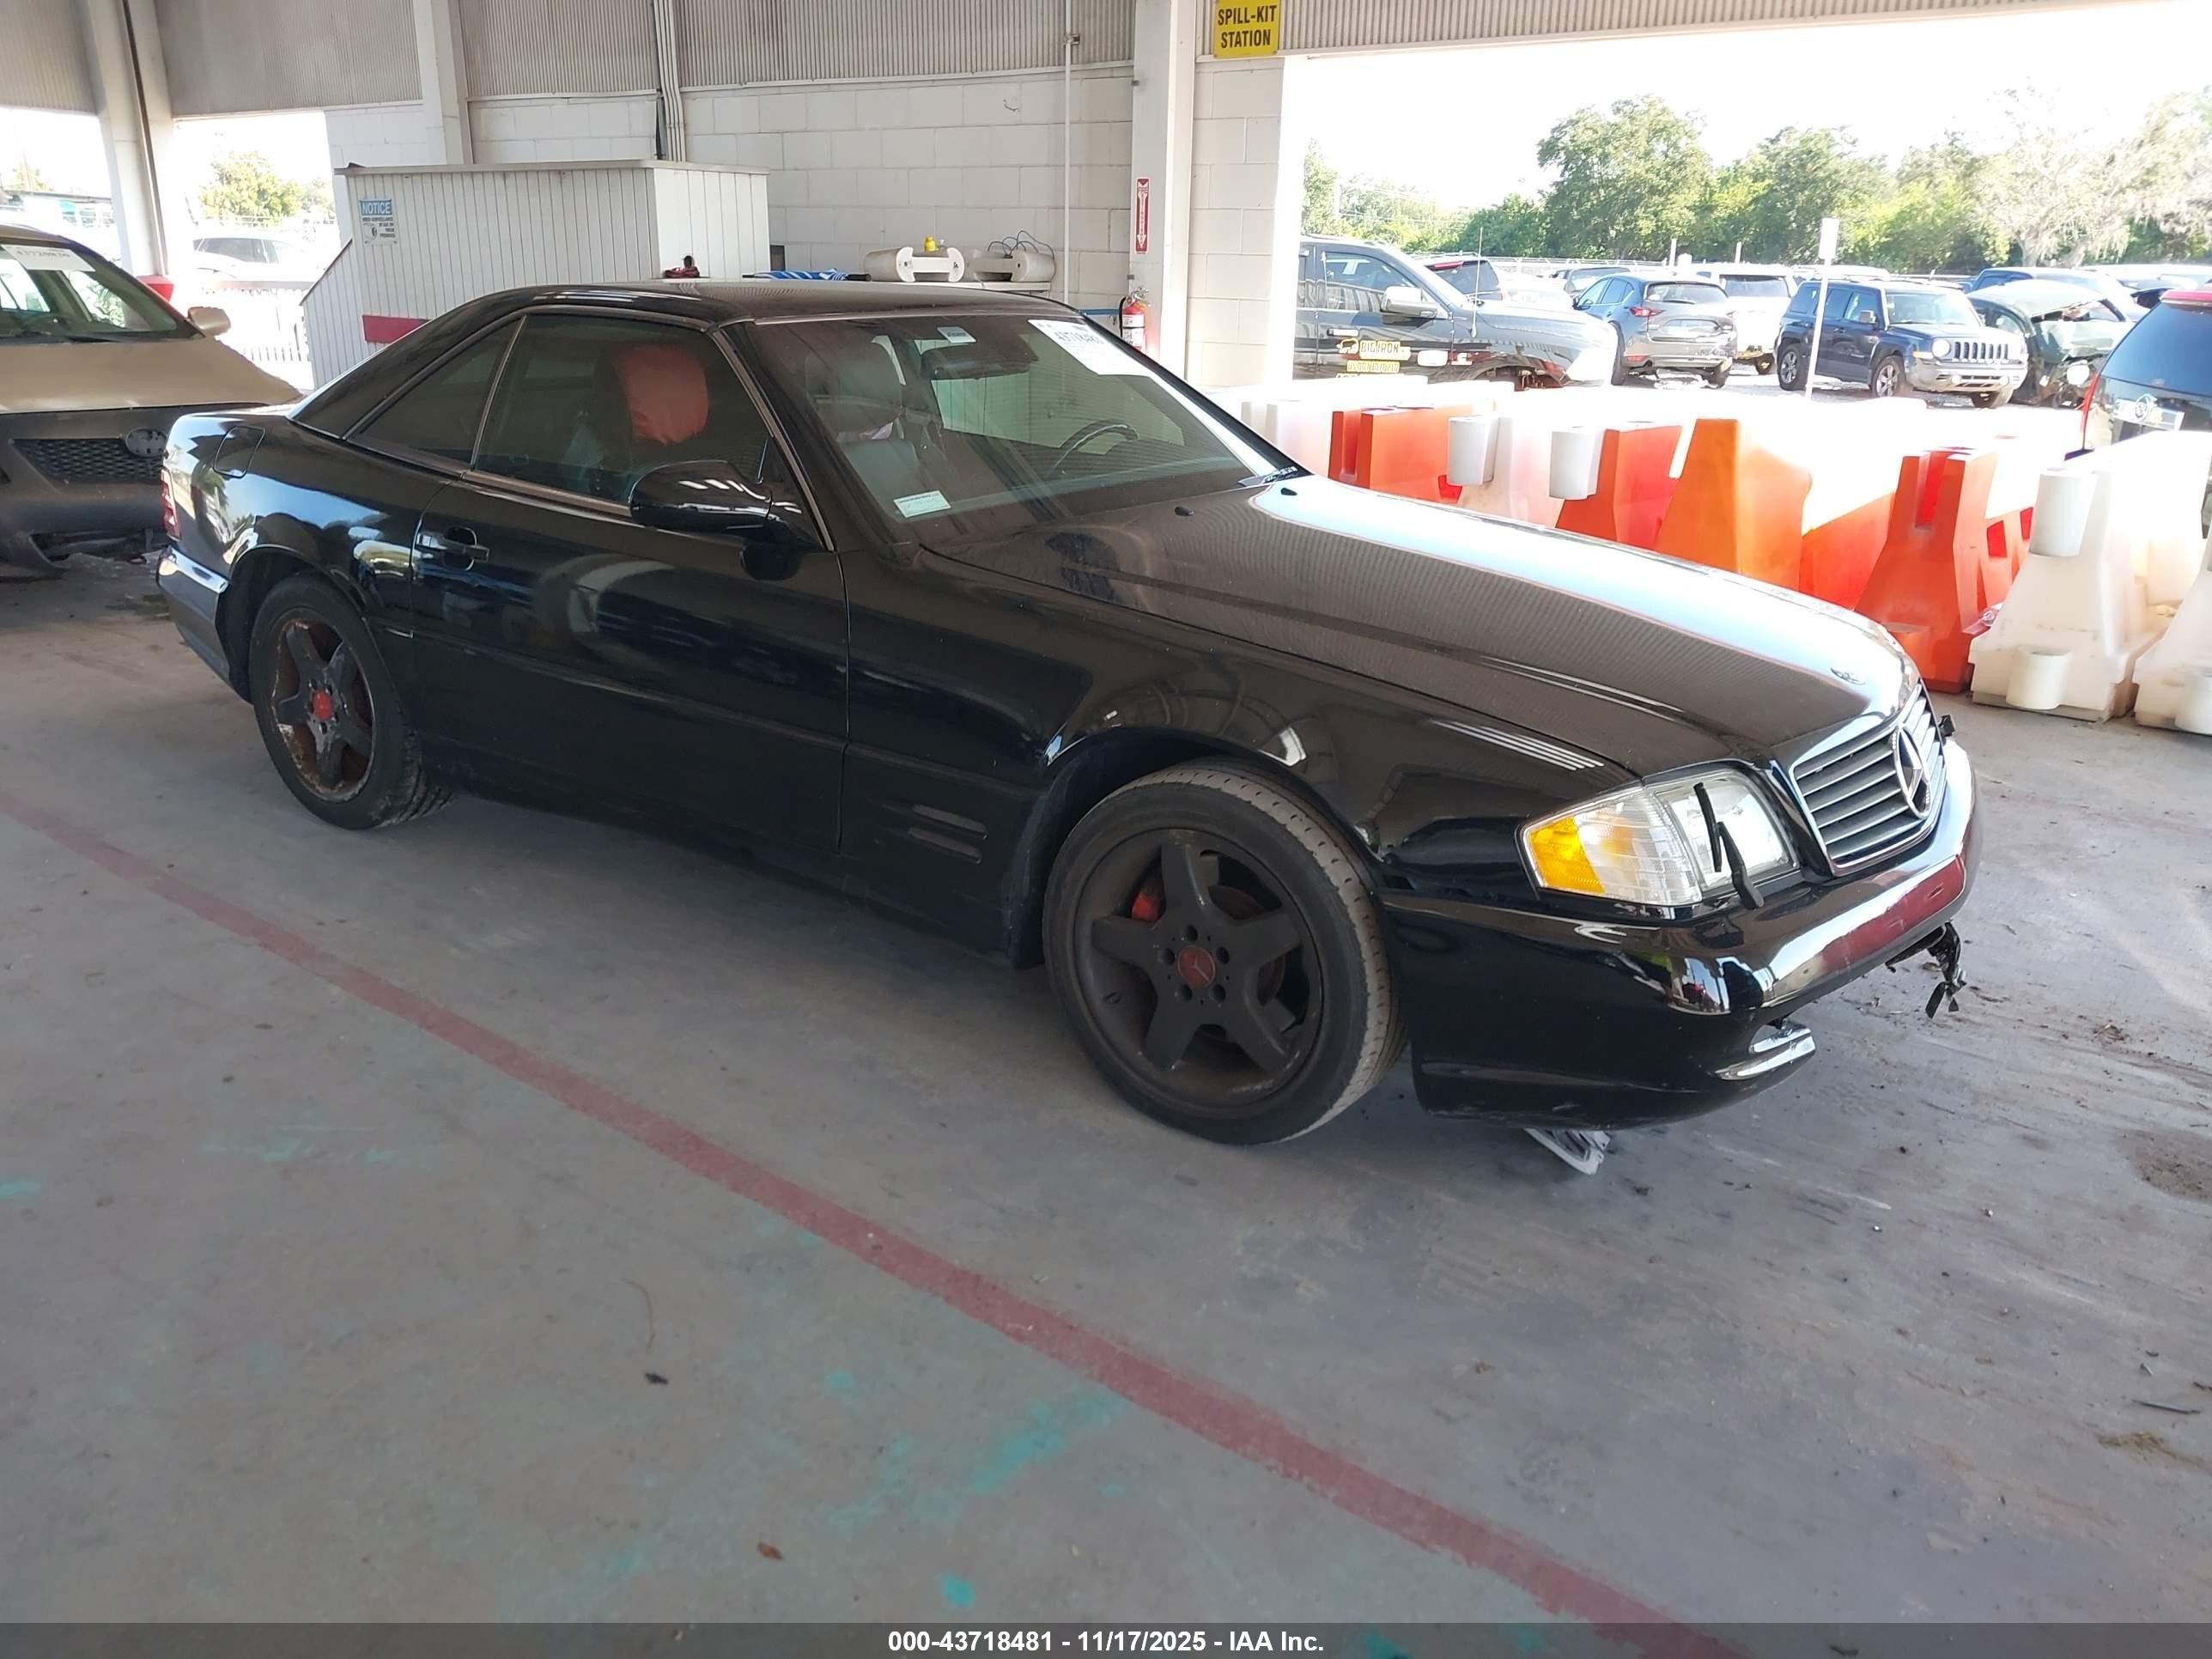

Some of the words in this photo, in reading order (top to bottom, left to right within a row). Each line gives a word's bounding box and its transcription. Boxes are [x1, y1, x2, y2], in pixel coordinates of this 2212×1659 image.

[1218, 5, 1277, 26] SPILL-KIT
[1221, 29, 1271, 48] STATION
[362, 202, 391, 214] NOTICE
